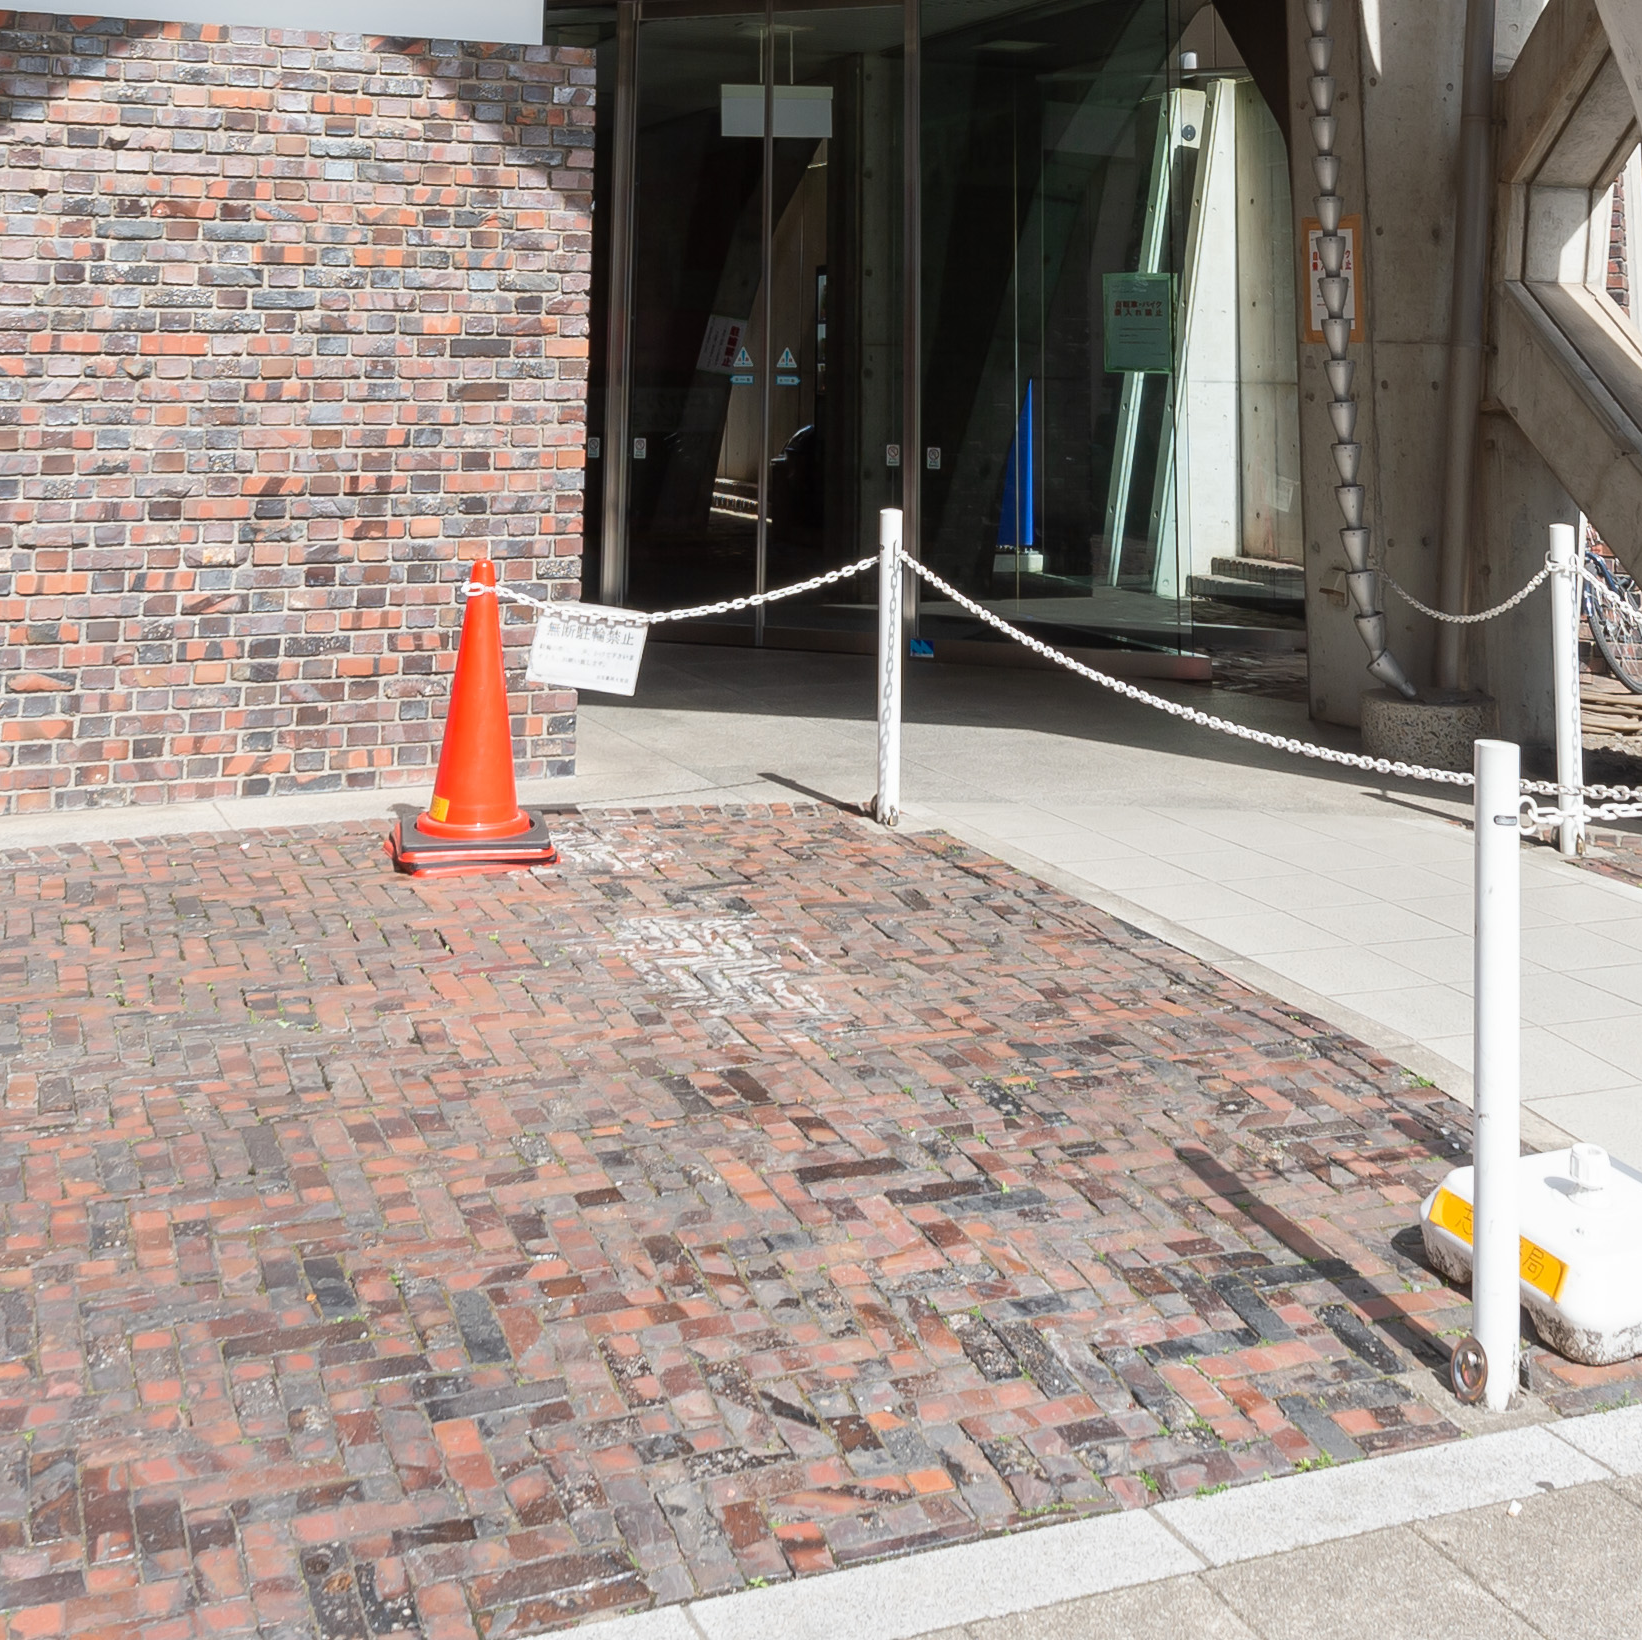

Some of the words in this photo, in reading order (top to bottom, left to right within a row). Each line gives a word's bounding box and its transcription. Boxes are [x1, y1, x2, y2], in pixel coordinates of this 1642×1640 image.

[547, 621, 635, 646] 無断駐輪禁止
